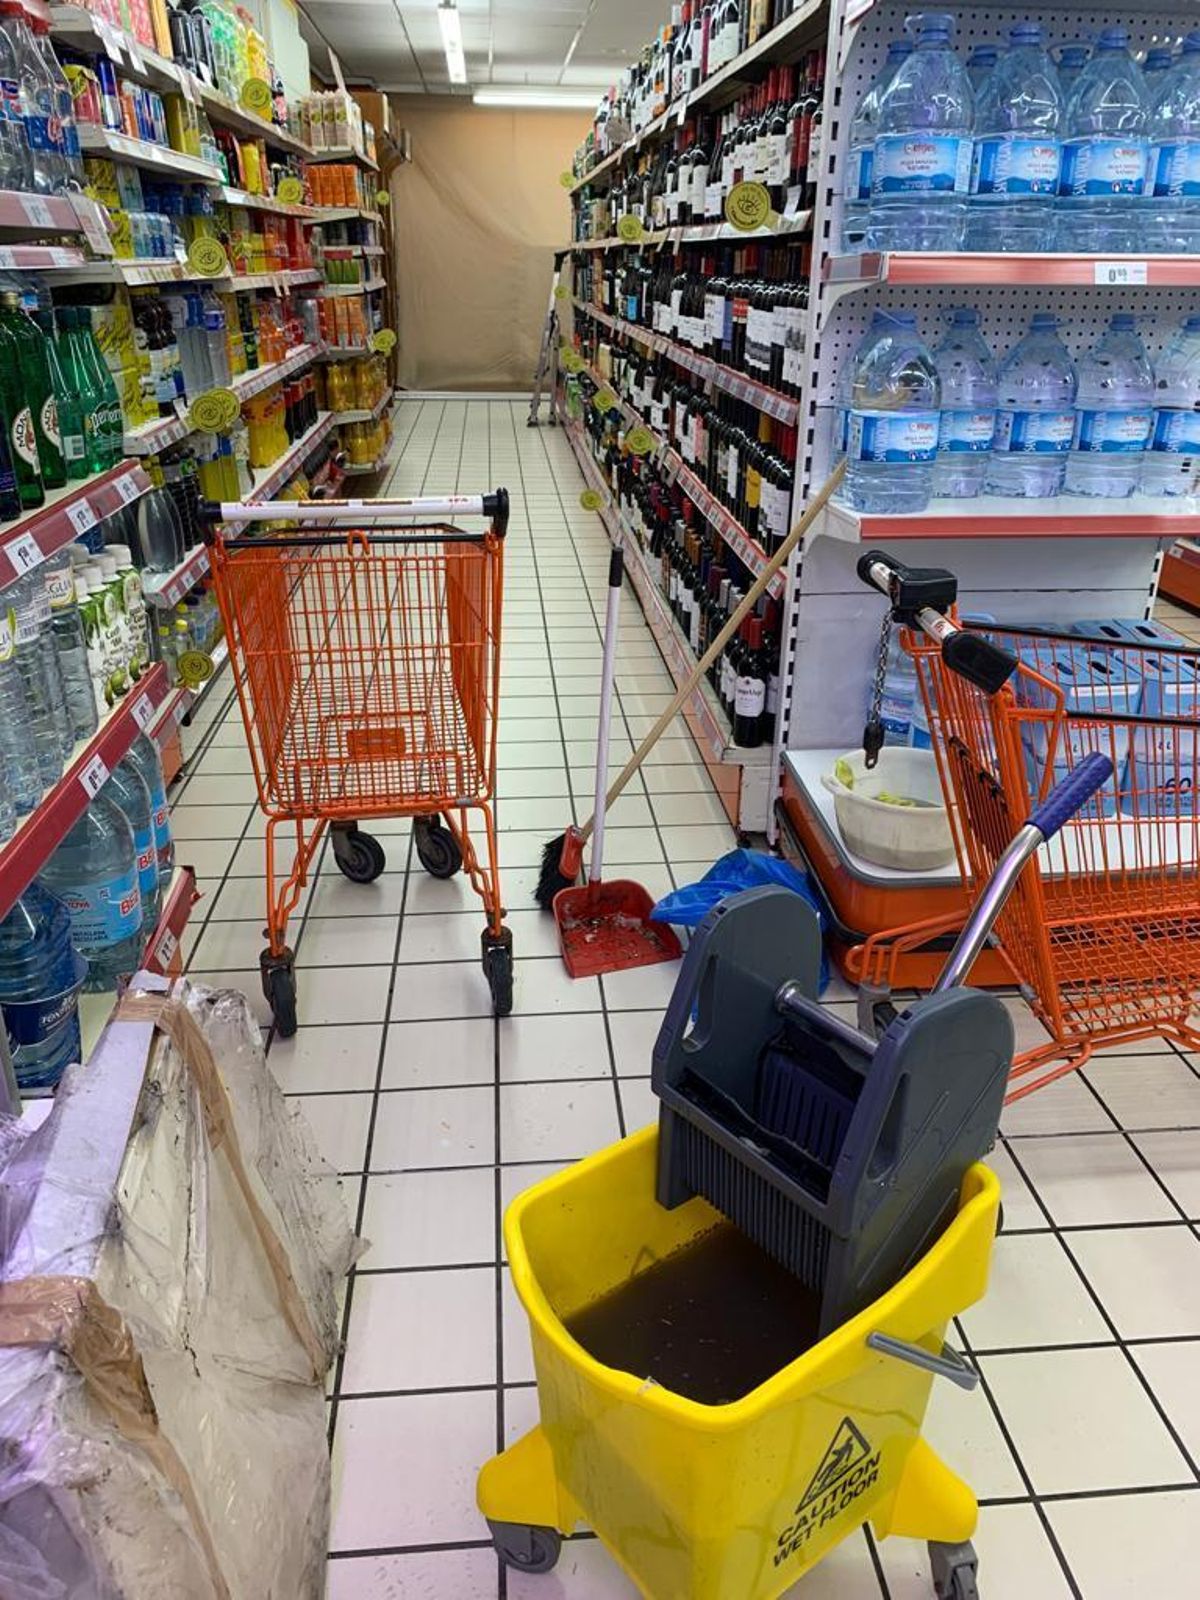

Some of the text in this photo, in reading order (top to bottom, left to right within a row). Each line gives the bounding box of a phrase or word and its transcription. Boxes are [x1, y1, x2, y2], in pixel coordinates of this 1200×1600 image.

[773, 1468, 879, 1568] WET FLOOR
[778, 1450, 881, 1548] CAUTION
